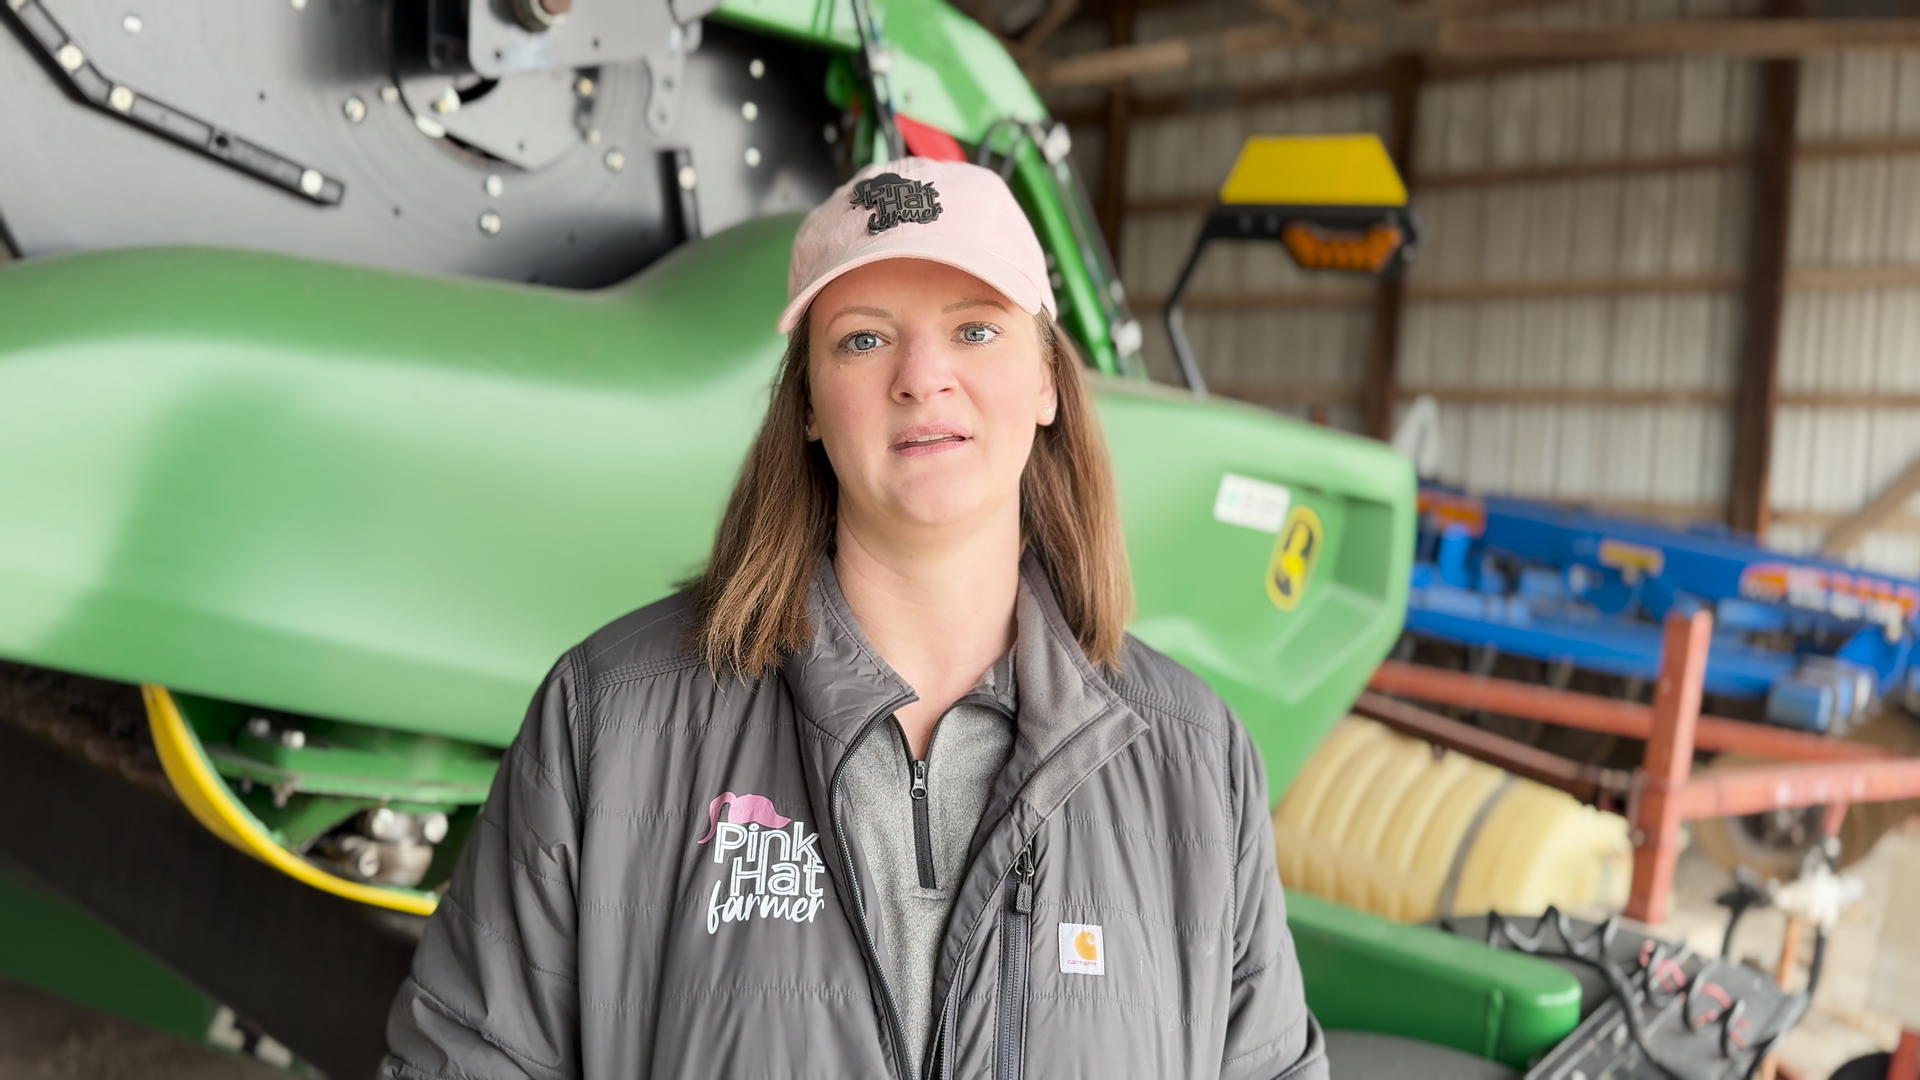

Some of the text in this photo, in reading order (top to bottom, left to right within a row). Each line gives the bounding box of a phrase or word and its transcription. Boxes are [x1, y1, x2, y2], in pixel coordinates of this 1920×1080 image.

[865, 180, 940, 207] Pink
[878, 190, 941, 215] Hat
[714, 821, 823, 863] Pink
[730, 857, 825, 897] Hat
[707, 880, 825, 935] farmer
